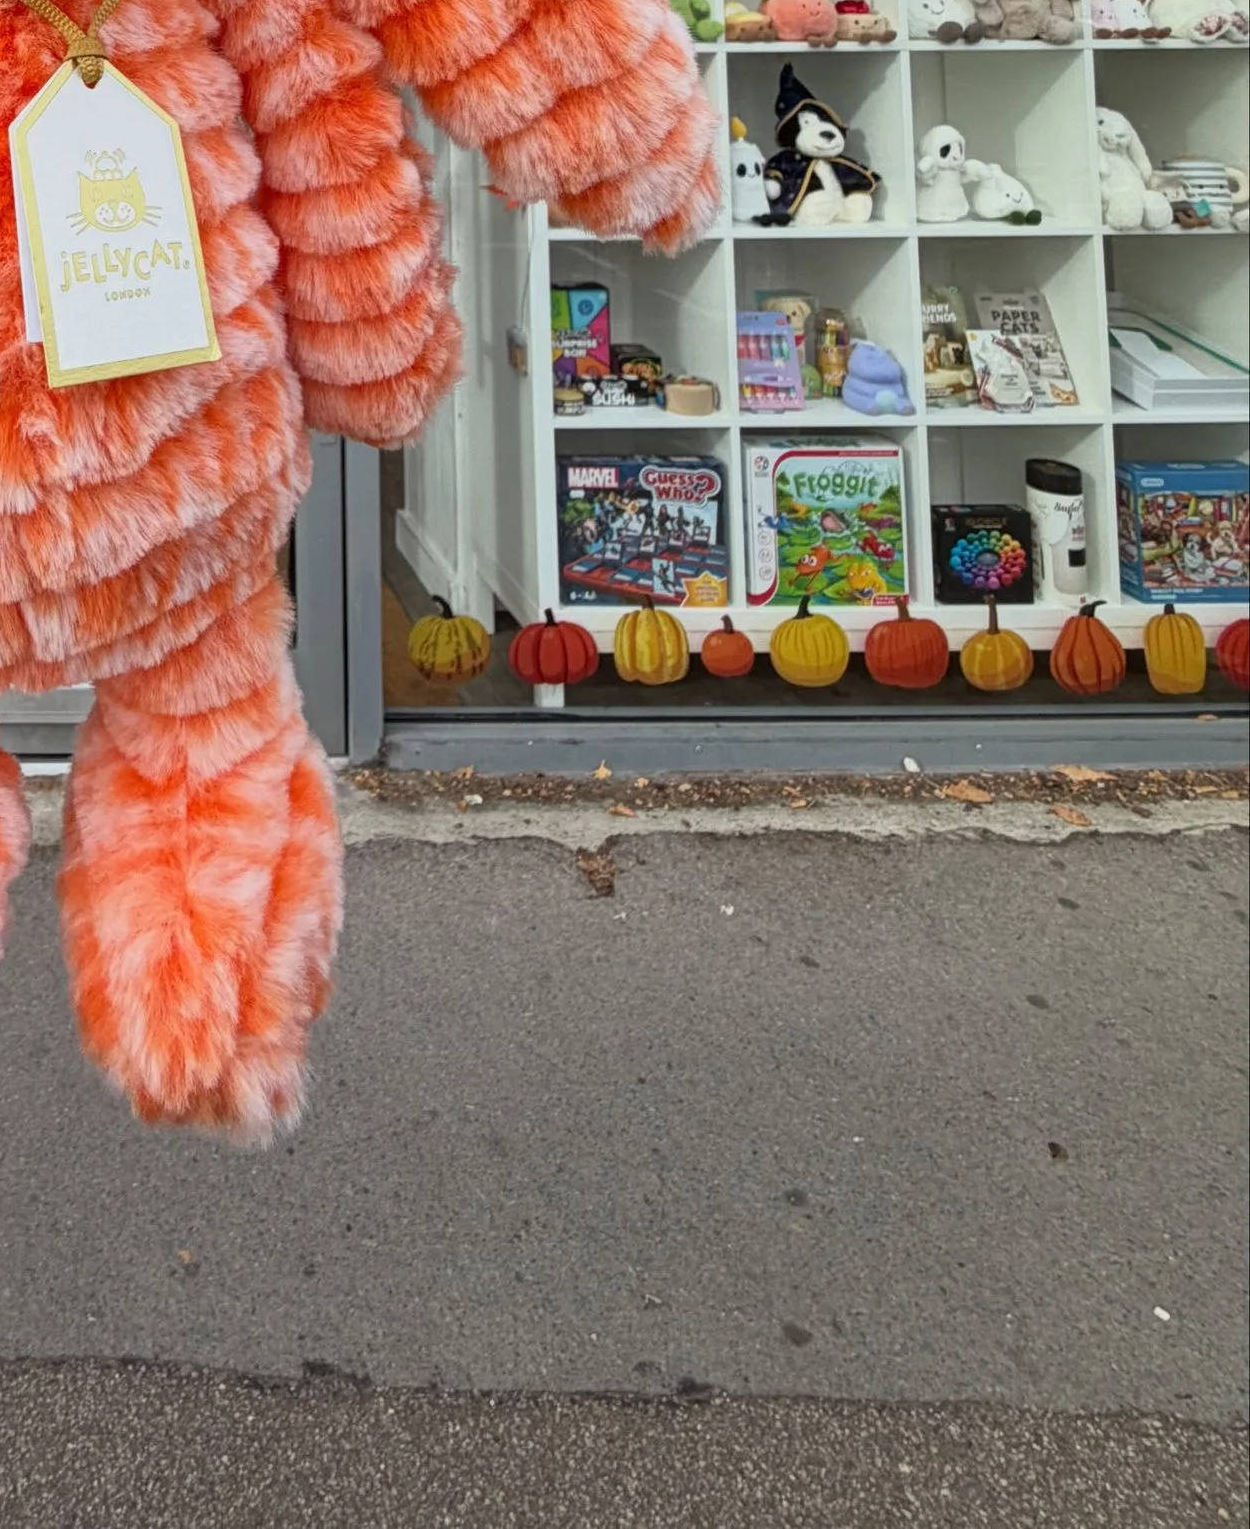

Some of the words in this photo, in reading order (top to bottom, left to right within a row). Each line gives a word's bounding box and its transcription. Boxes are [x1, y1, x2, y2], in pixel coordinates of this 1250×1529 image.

[104, 286, 151, 303] LONDON
[990, 310, 1041, 322] PAPER
[1000, 322, 1040, 336] CATS
[568, 467, 619, 489] MARVEL
